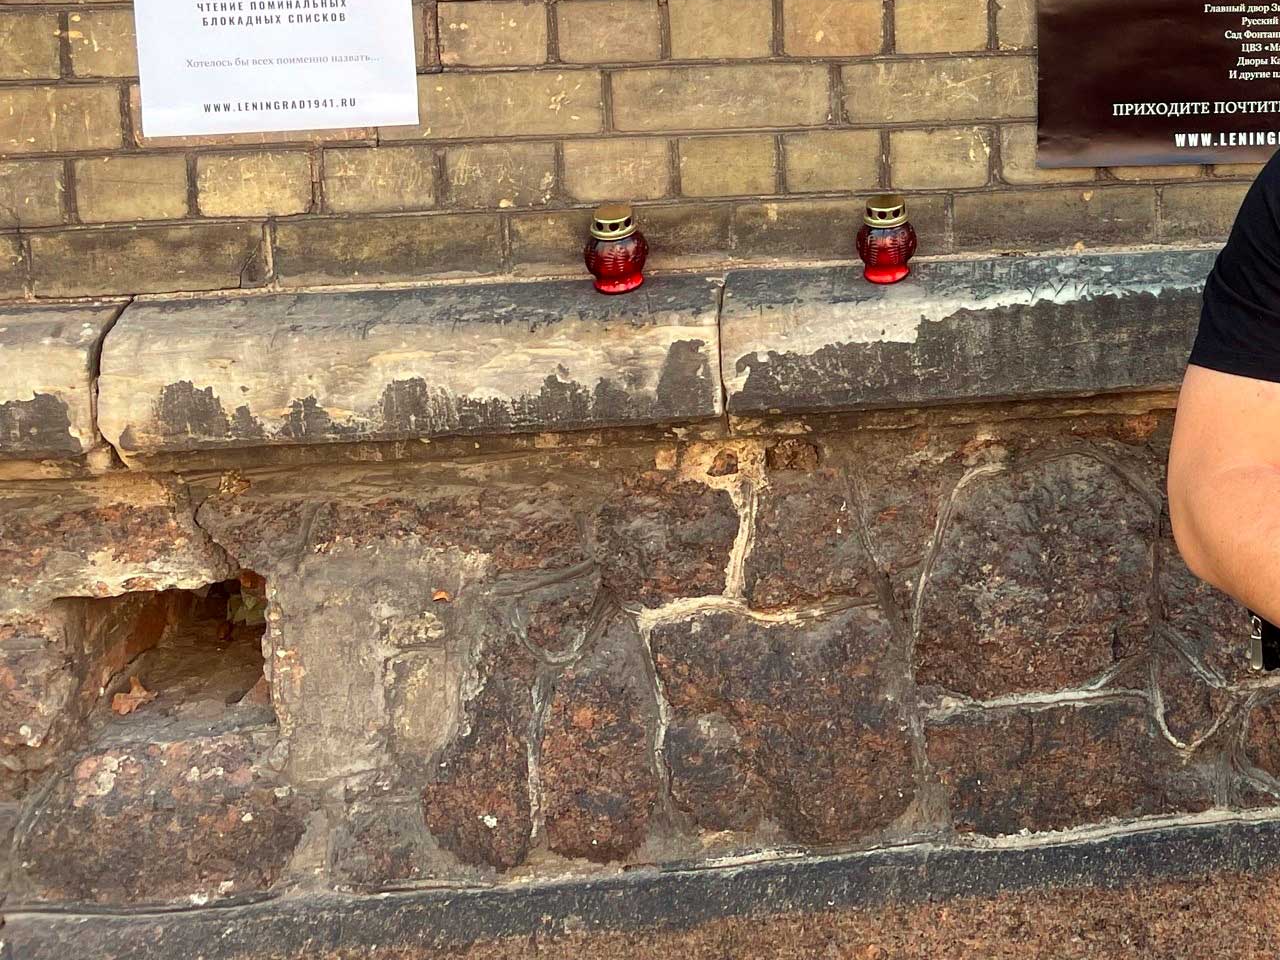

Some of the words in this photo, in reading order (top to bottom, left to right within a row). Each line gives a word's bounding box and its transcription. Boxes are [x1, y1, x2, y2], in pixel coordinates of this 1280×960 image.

[197, 1, 243, 12] ЧТЕНИЕ
[1204, 3, 1244, 13] Главный
[1248, 3, 1269, 14] двор
[202, 14, 282, 27] БЛОКАДНЫХ
[288, 12, 346, 23] СПИСКОВ
[1242, 16, 1278, 27] Русский
[1224, 30, 1242, 41] Сад
[1242, 43, 1262, 53] ЦВЗ
[186, 58, 233, 68] Хотелось
[235, 57, 249, 67] бы
[252, 58, 274, 67] всех
[276, 56, 328, 66] поименно
[1237, 56, 1268, 67] Дворы
[1229, 70, 1237, 80] И
[1239, 70, 1271, 81] другие
[204, 97, 356, 113] WWW.LENINGRAD1941.RU
[1112, 101, 1210, 118] ПРИХОДИТЕ
